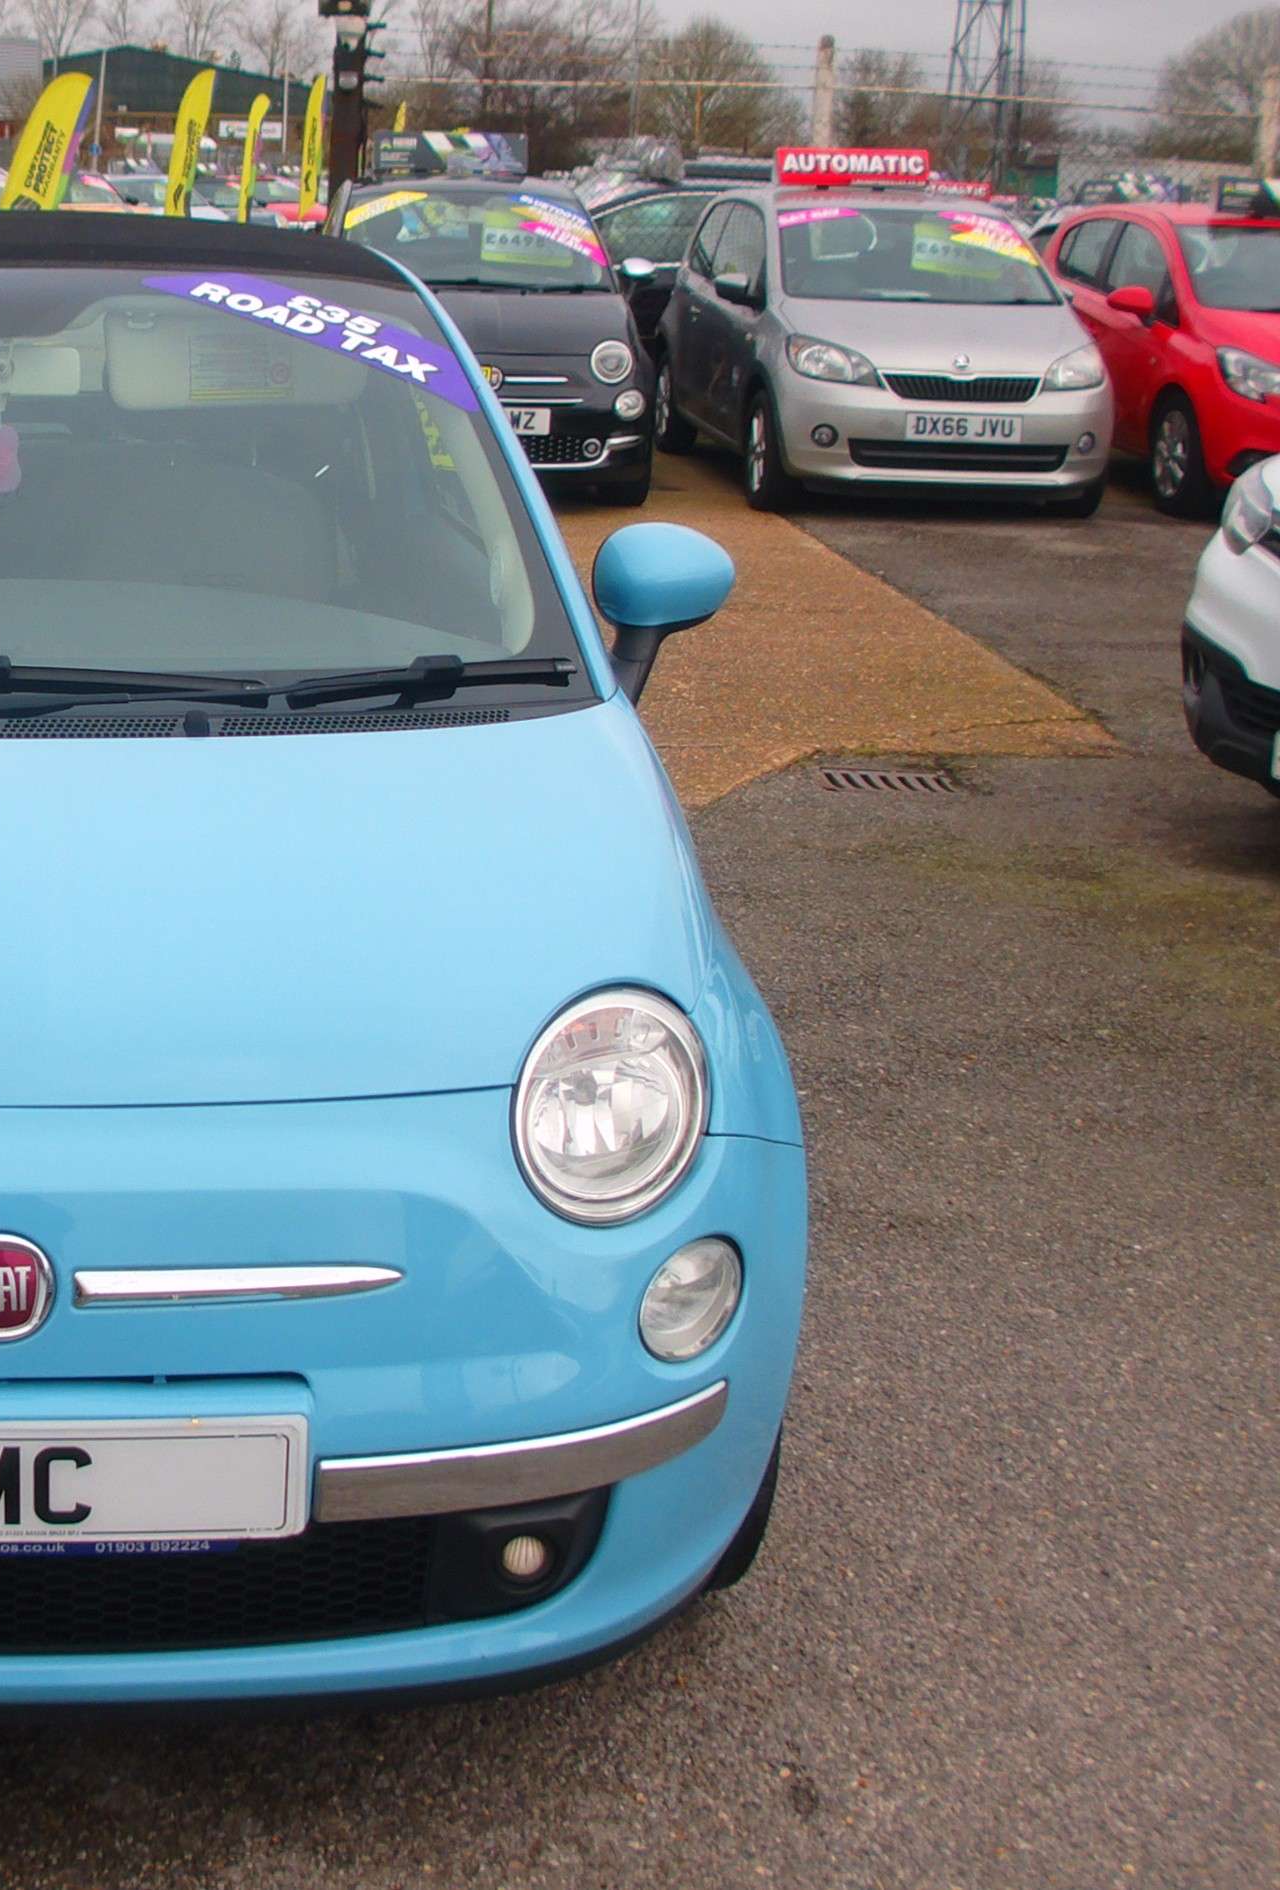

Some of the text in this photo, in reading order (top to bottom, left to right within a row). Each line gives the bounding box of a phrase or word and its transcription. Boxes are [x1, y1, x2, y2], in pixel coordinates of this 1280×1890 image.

[33, 126, 59, 194] PROTECT
[783, 153, 924, 175] AUTOMATIC
[287, 295, 382, 336] £35
[190, 281, 325, 335] ROAD
[340, 329, 438, 383] TAX
[915, 416, 1014, 438] DX66 JVU
[95, 1541, 145, 1553] 01903
[150, 1540, 210, 1553] 892224
